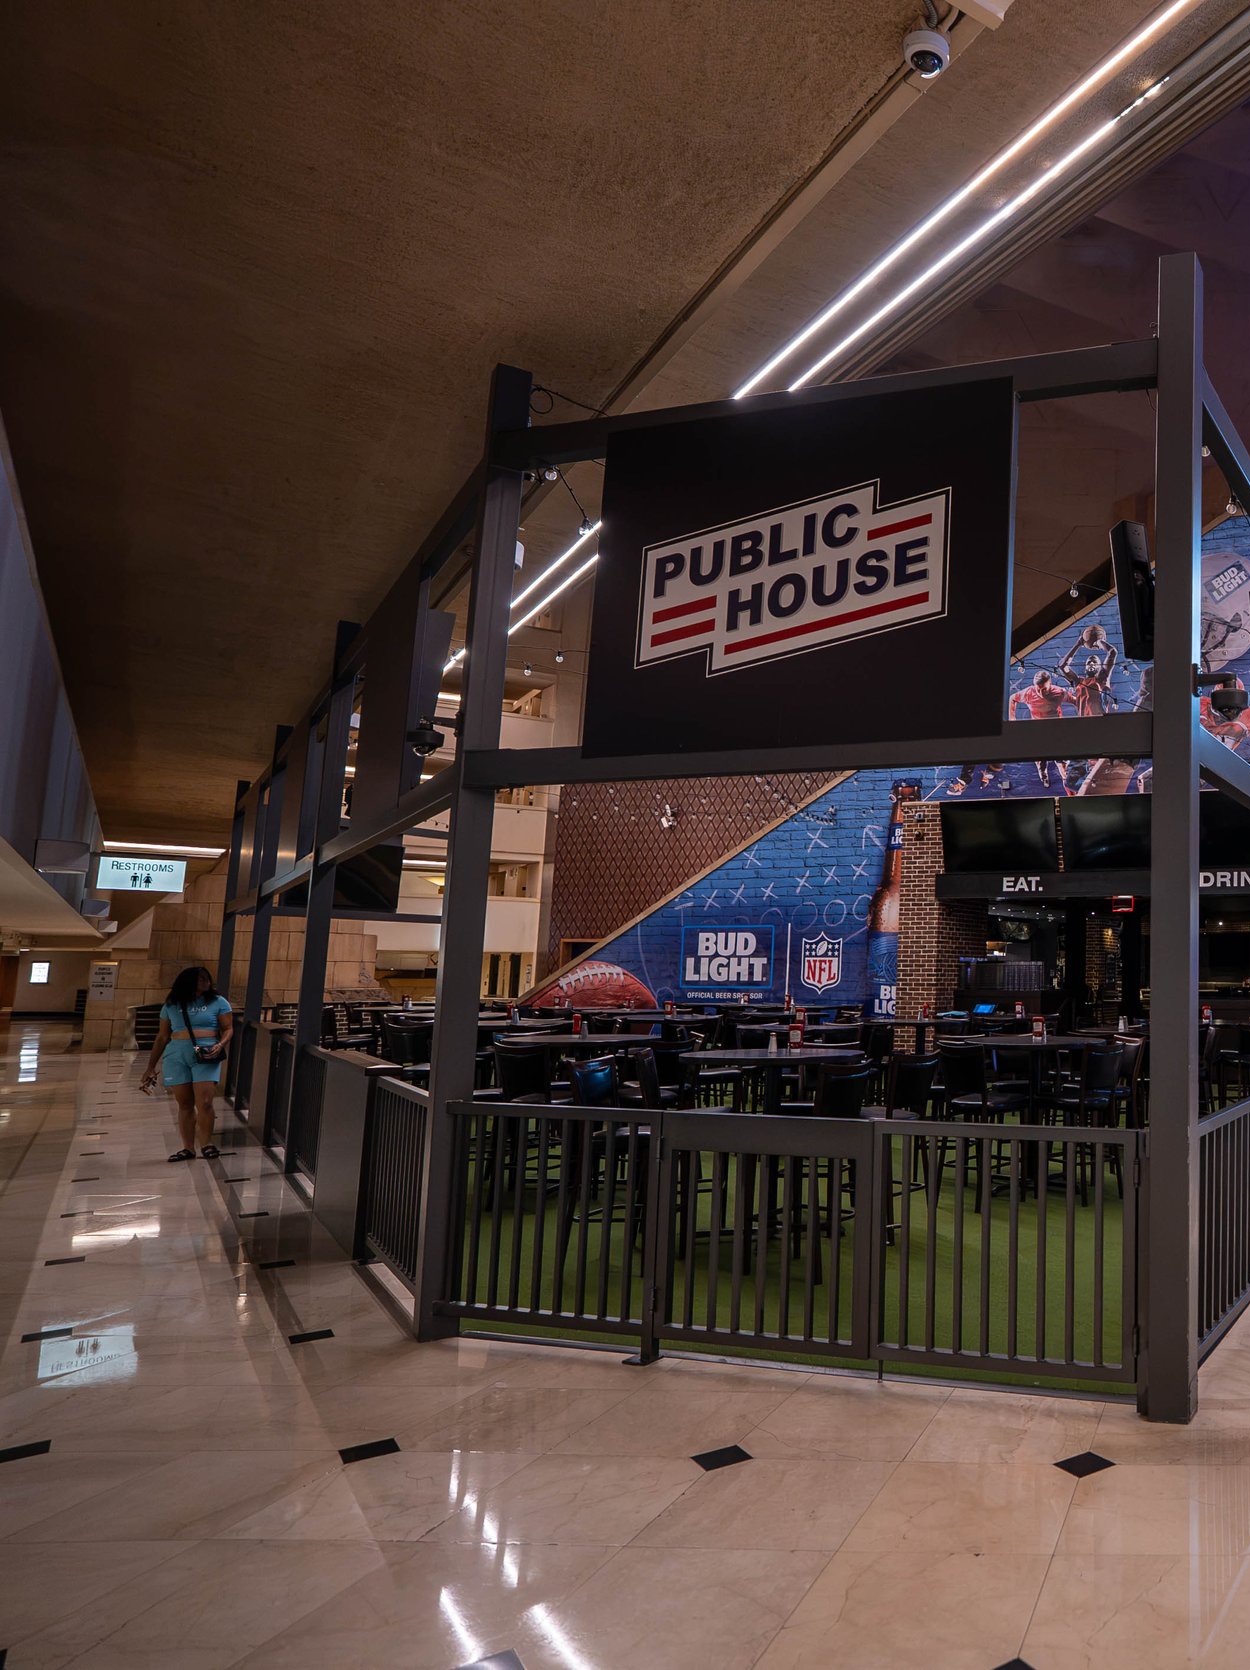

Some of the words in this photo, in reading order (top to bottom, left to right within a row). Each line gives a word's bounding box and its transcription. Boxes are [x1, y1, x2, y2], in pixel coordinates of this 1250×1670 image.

[653, 503, 860, 599] PUBLIC
[726, 536, 930, 633] HOUSE
[1211, 567, 1238, 590] BUD
[1212, 571, 1249, 600] LIGHT
[111, 860, 174, 873] RESTROOMS
[1002, 877, 1043, 892] EAT.
[697, 932, 757, 956] BUD
[685, 957, 768, 981] LIGHT
[806, 959, 836, 985] NFL
[687, 991, 714, 999] OFFICIAL
